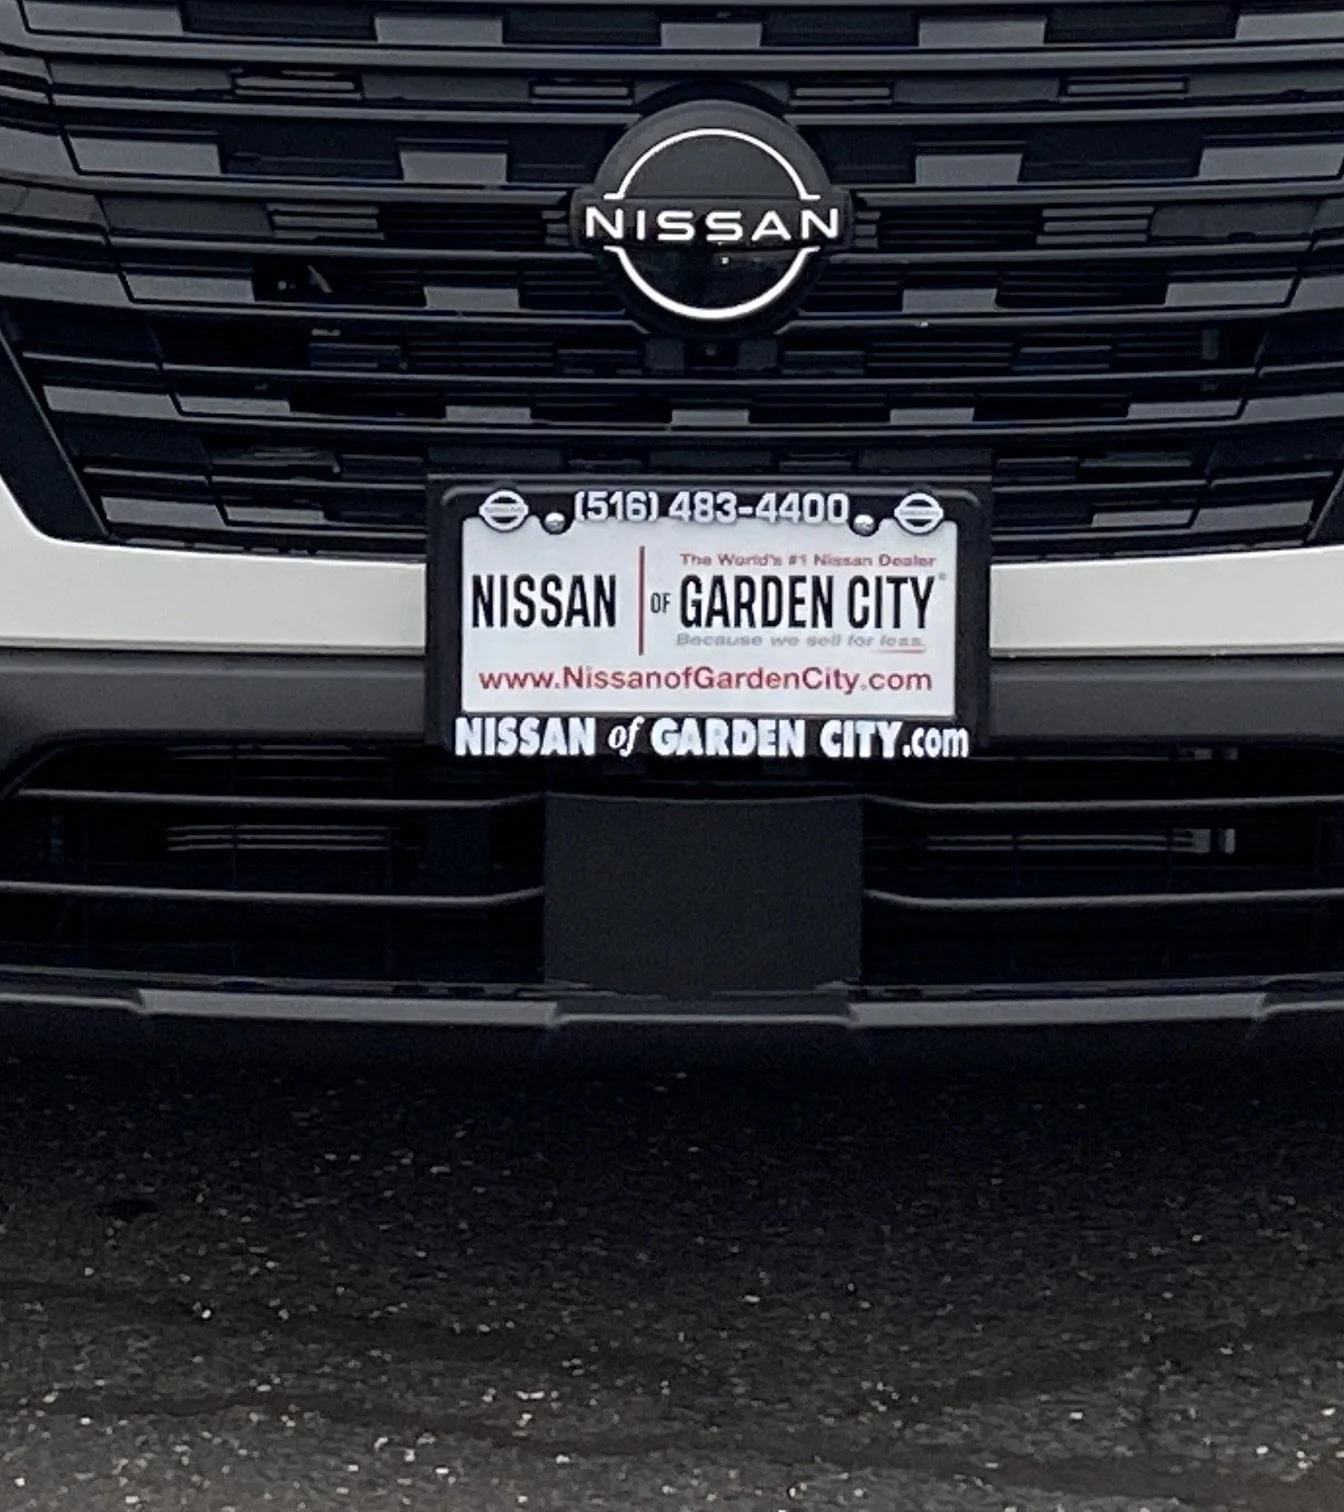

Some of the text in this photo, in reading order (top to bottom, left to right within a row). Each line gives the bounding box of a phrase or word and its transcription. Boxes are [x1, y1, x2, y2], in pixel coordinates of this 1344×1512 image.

[584, 206, 839, 241] NISSAN
[573, 491, 850, 524] (516) 483-4400
[679, 553, 937, 567] The World's #1 Nissan Dealer
[472, 574, 935, 629] NISSAN OF GARDEN CITY
[676, 633, 763, 647] Because
[770, 635, 798, 647] we
[806, 633, 841, 647] sell
[847, 633, 875, 647] for
[478, 665, 933, 695] www.NissanofGardenCity.com
[455, 715, 969, 758] NISSAN of GARDEN CITY.com
